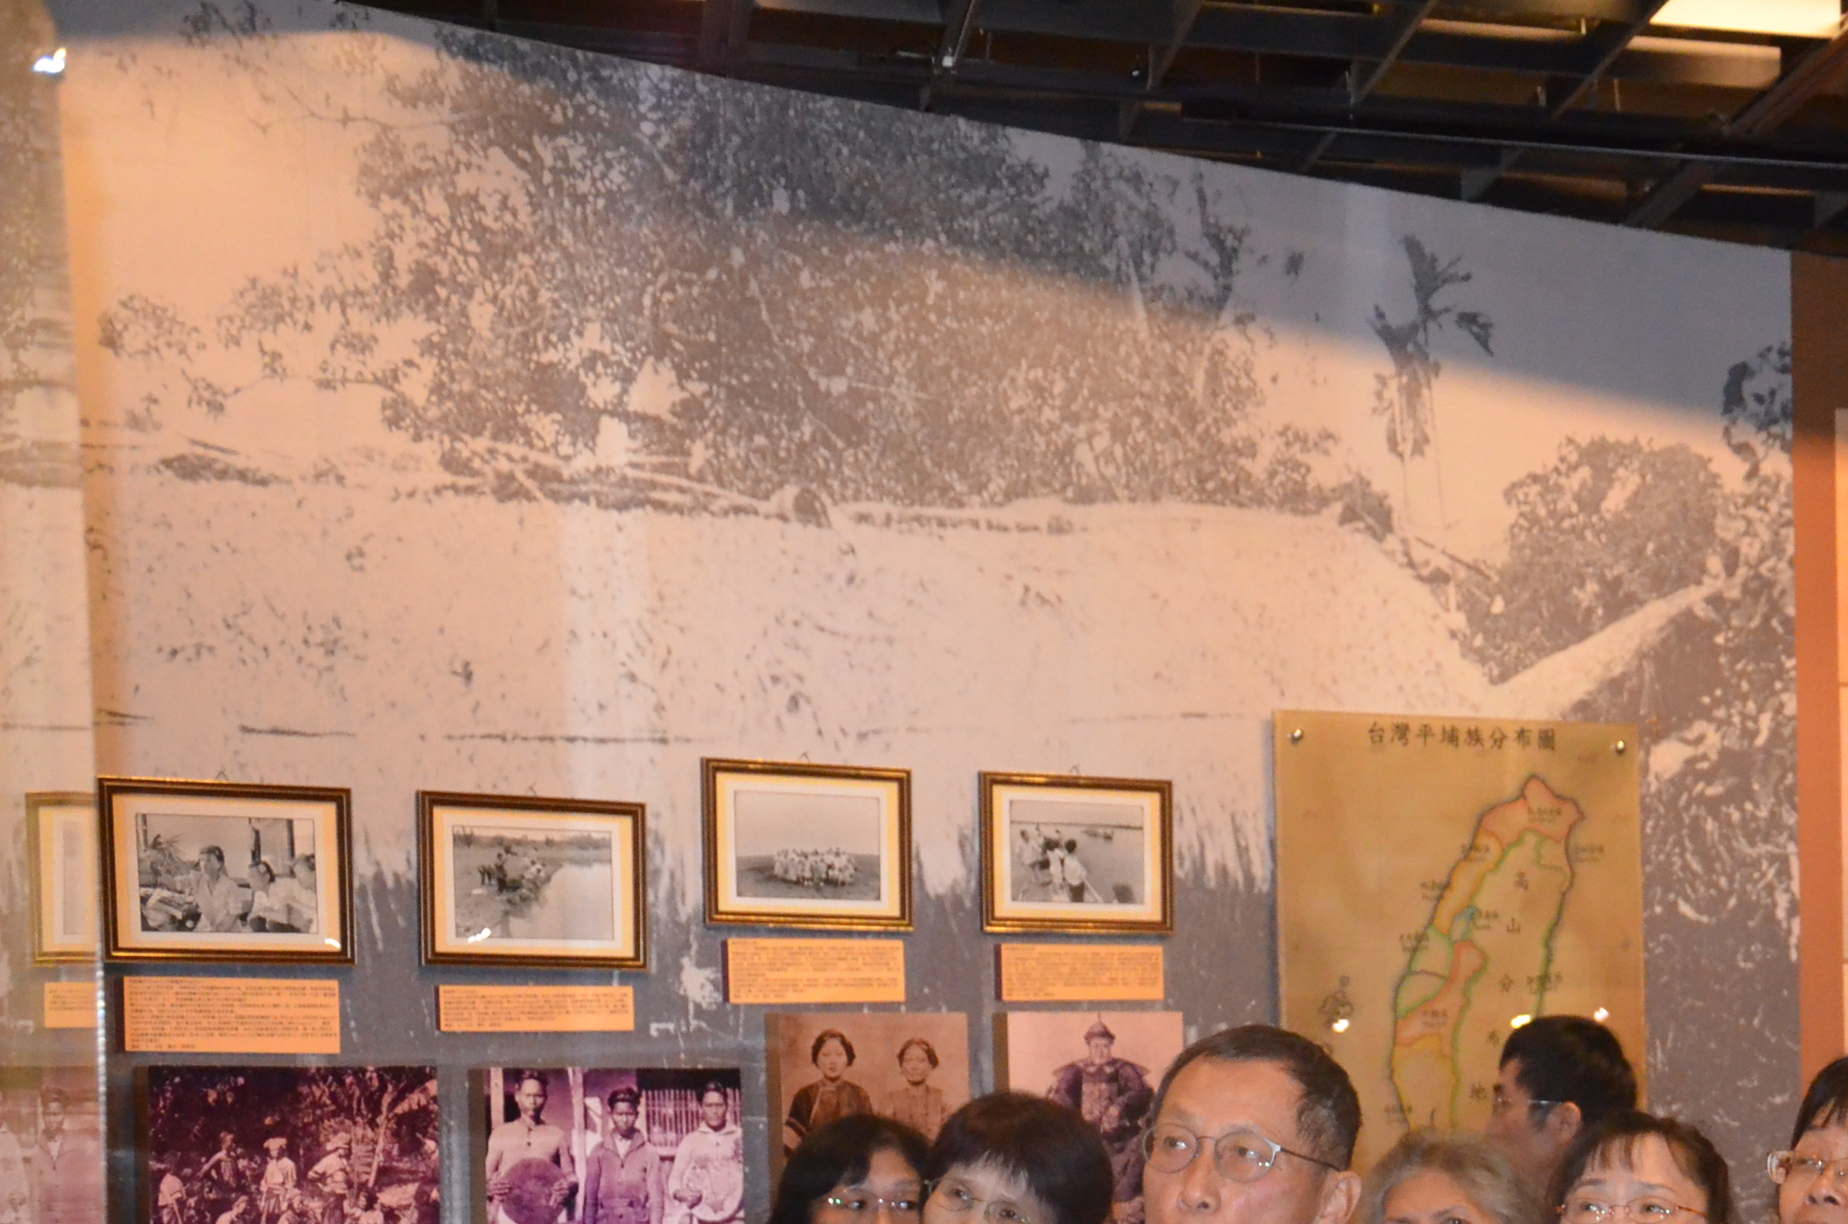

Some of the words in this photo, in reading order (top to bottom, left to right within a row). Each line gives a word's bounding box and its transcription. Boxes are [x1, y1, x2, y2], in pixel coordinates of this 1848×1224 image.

[1367, 720, 1556, 751] 台灣平埔族分布圖
